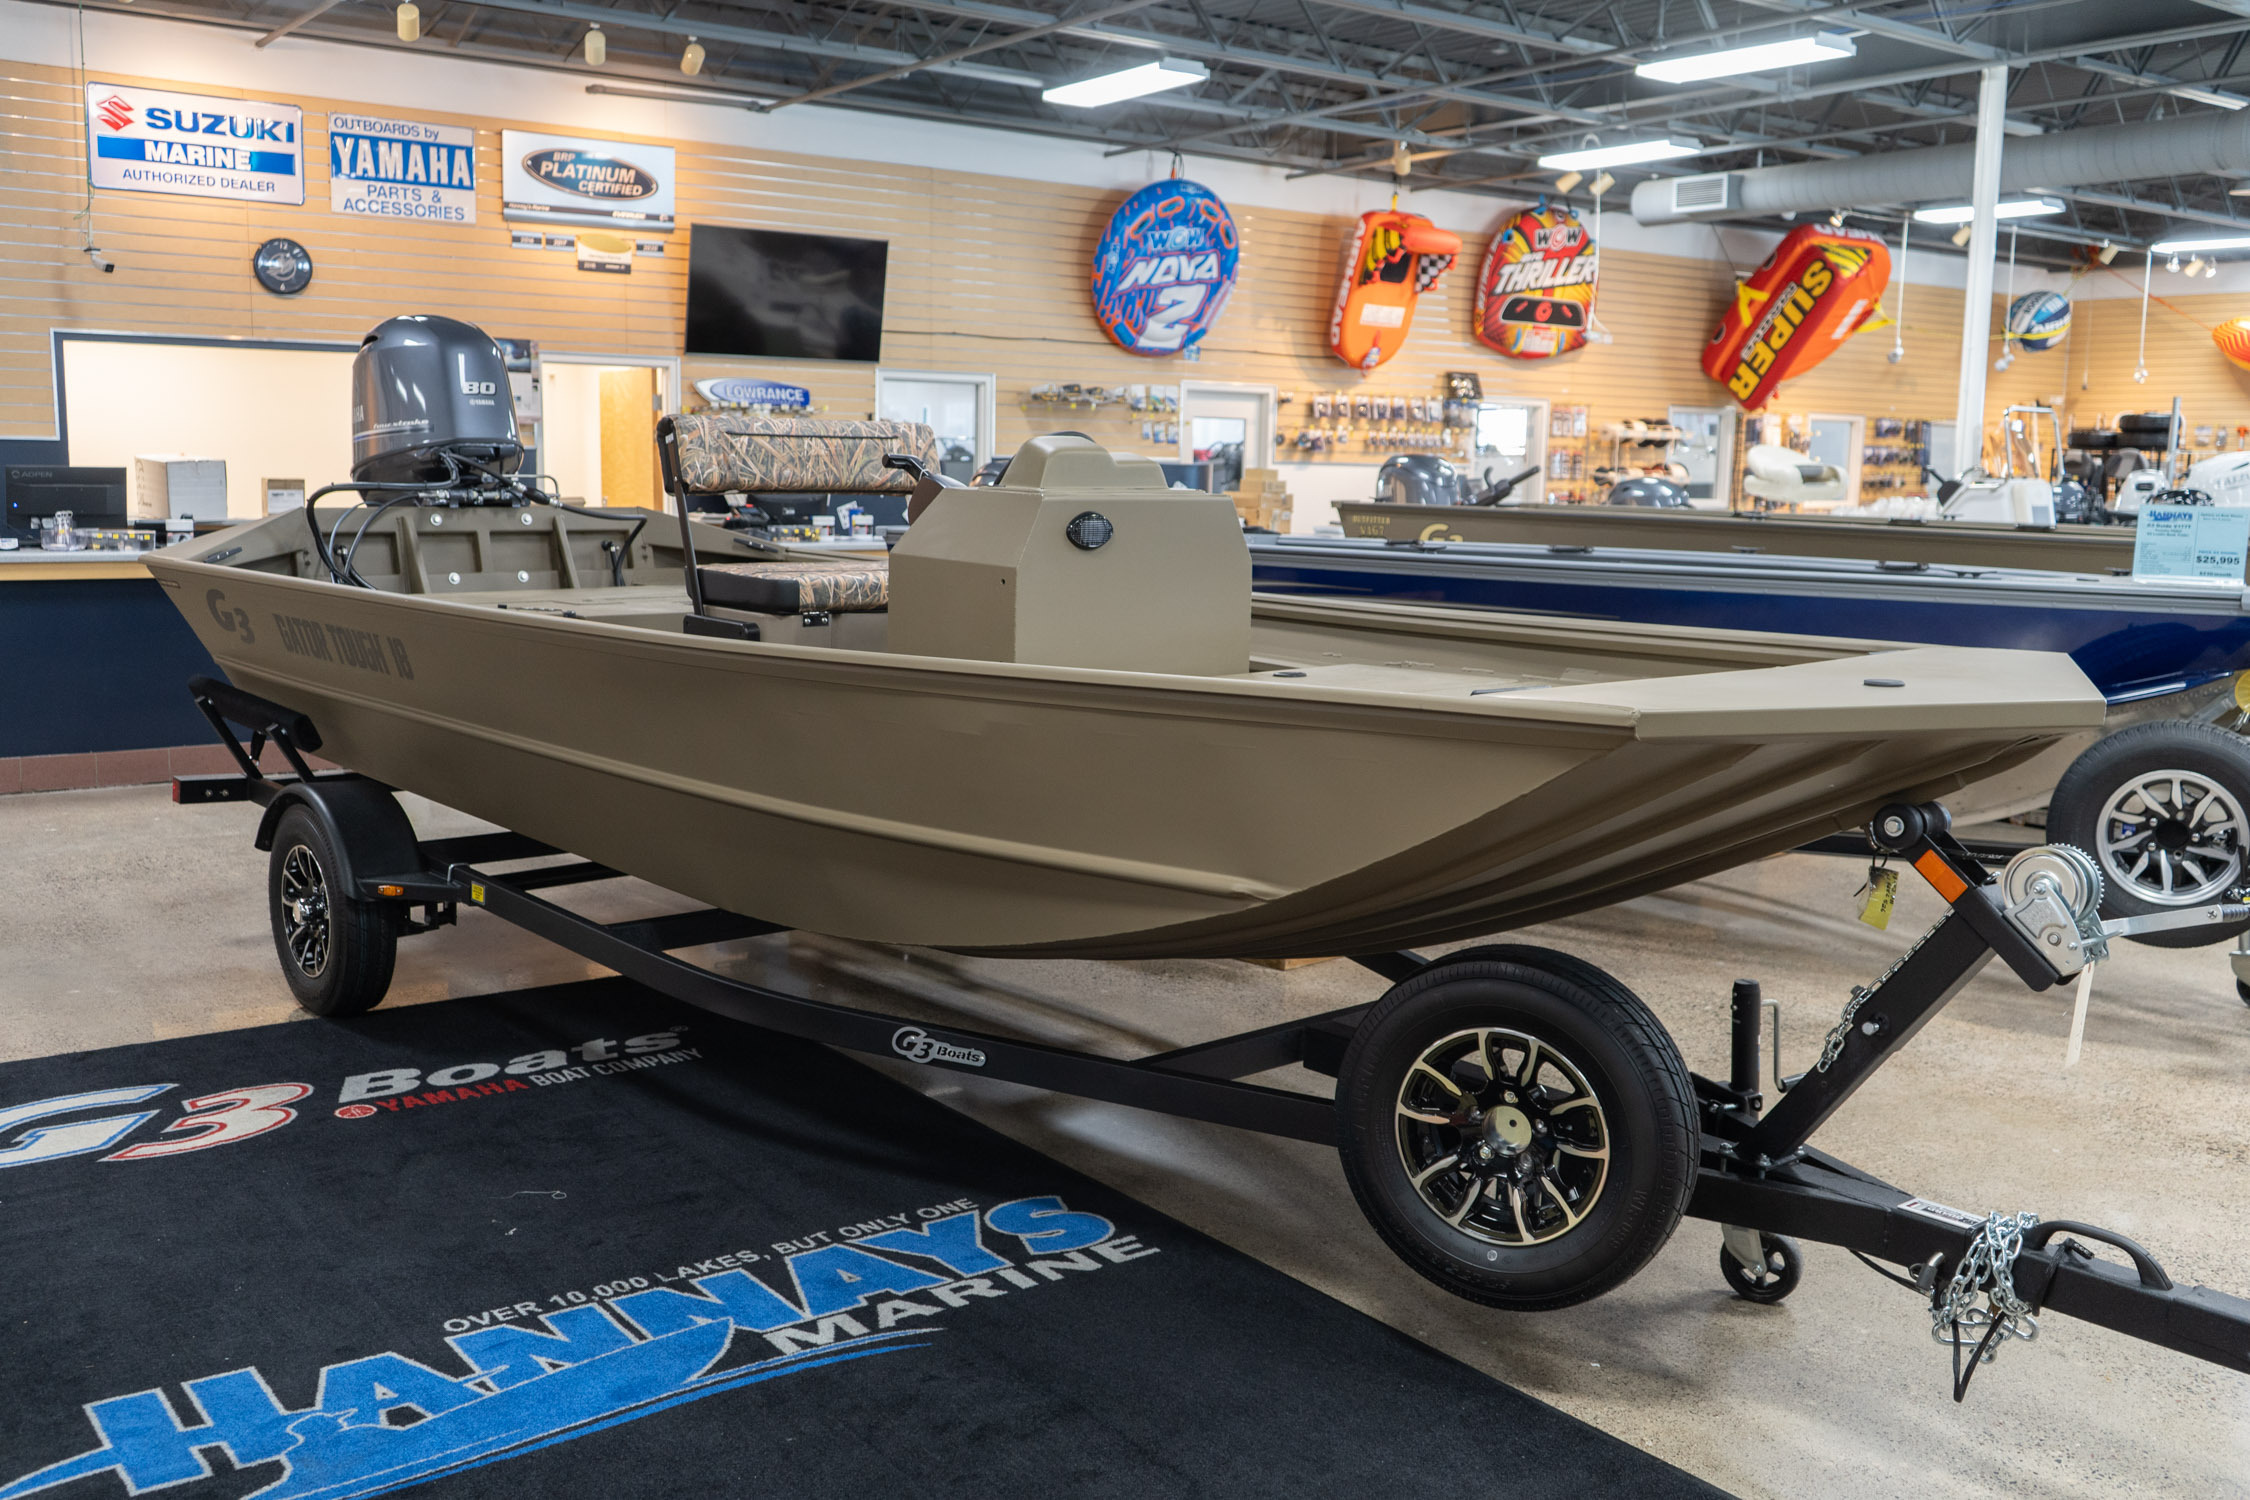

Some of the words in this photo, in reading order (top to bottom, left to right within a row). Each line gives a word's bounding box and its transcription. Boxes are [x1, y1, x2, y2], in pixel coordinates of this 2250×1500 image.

[145, 107, 295, 143] SUZUKI
[333, 116, 420, 138] OUTBOARDS
[424, 127, 440, 142] by
[144, 139, 252, 171] MARINE
[333, 135, 473, 187] YAMAHA
[552, 151, 576, 163] BRP
[122, 168, 216, 187] AUTHORIZED
[220, 177, 276, 193] DEALER
[539, 161, 637, 184] PLATINUM
[577, 180, 643, 197] CERTIFIED
[343, 197, 465, 221] ACCESSORIES
[367, 184, 422, 202] PARTS
[431, 189, 442, 204] &
[1148, 226, 1206, 251] WOW
[1534, 223, 1584, 252] WOW
[1117, 252, 1220, 292] NOVA
[1492, 253, 1598, 296] THRILLER
[1136, 283, 1208, 350] 2
[1728, 259, 1834, 401] SUPER
[725, 384, 805, 402] LOWRANCE
[2196, 555, 2240, 565] $25,995
[206, 588, 256, 645] G3
[272, 612, 333, 662] GATOR
[325, 623, 391, 676] TOUGH
[386, 636, 415, 681] 18
[894, 1030, 935, 1059] G3
[936, 1046, 981, 1062] Boats
[338, 1032, 681, 1103] Boats
[375, 1078, 530, 1113] YAMAHA
[528, 1066, 592, 1088] BOAT
[592, 1047, 704, 1077] COMPANY
[443, 1300, 540, 1335] OVER
[548, 1275, 649, 1310] 10,000
[655, 1235, 772, 1283] LAKES,
[771, 1229, 830, 1257] BUT
[838, 1212, 912, 1239] ONLY
[915, 1197, 979, 1221] ONE
[762, 1232, 1162, 1356] MARINE
[80, 1195, 1117, 1498] HANNAYS
